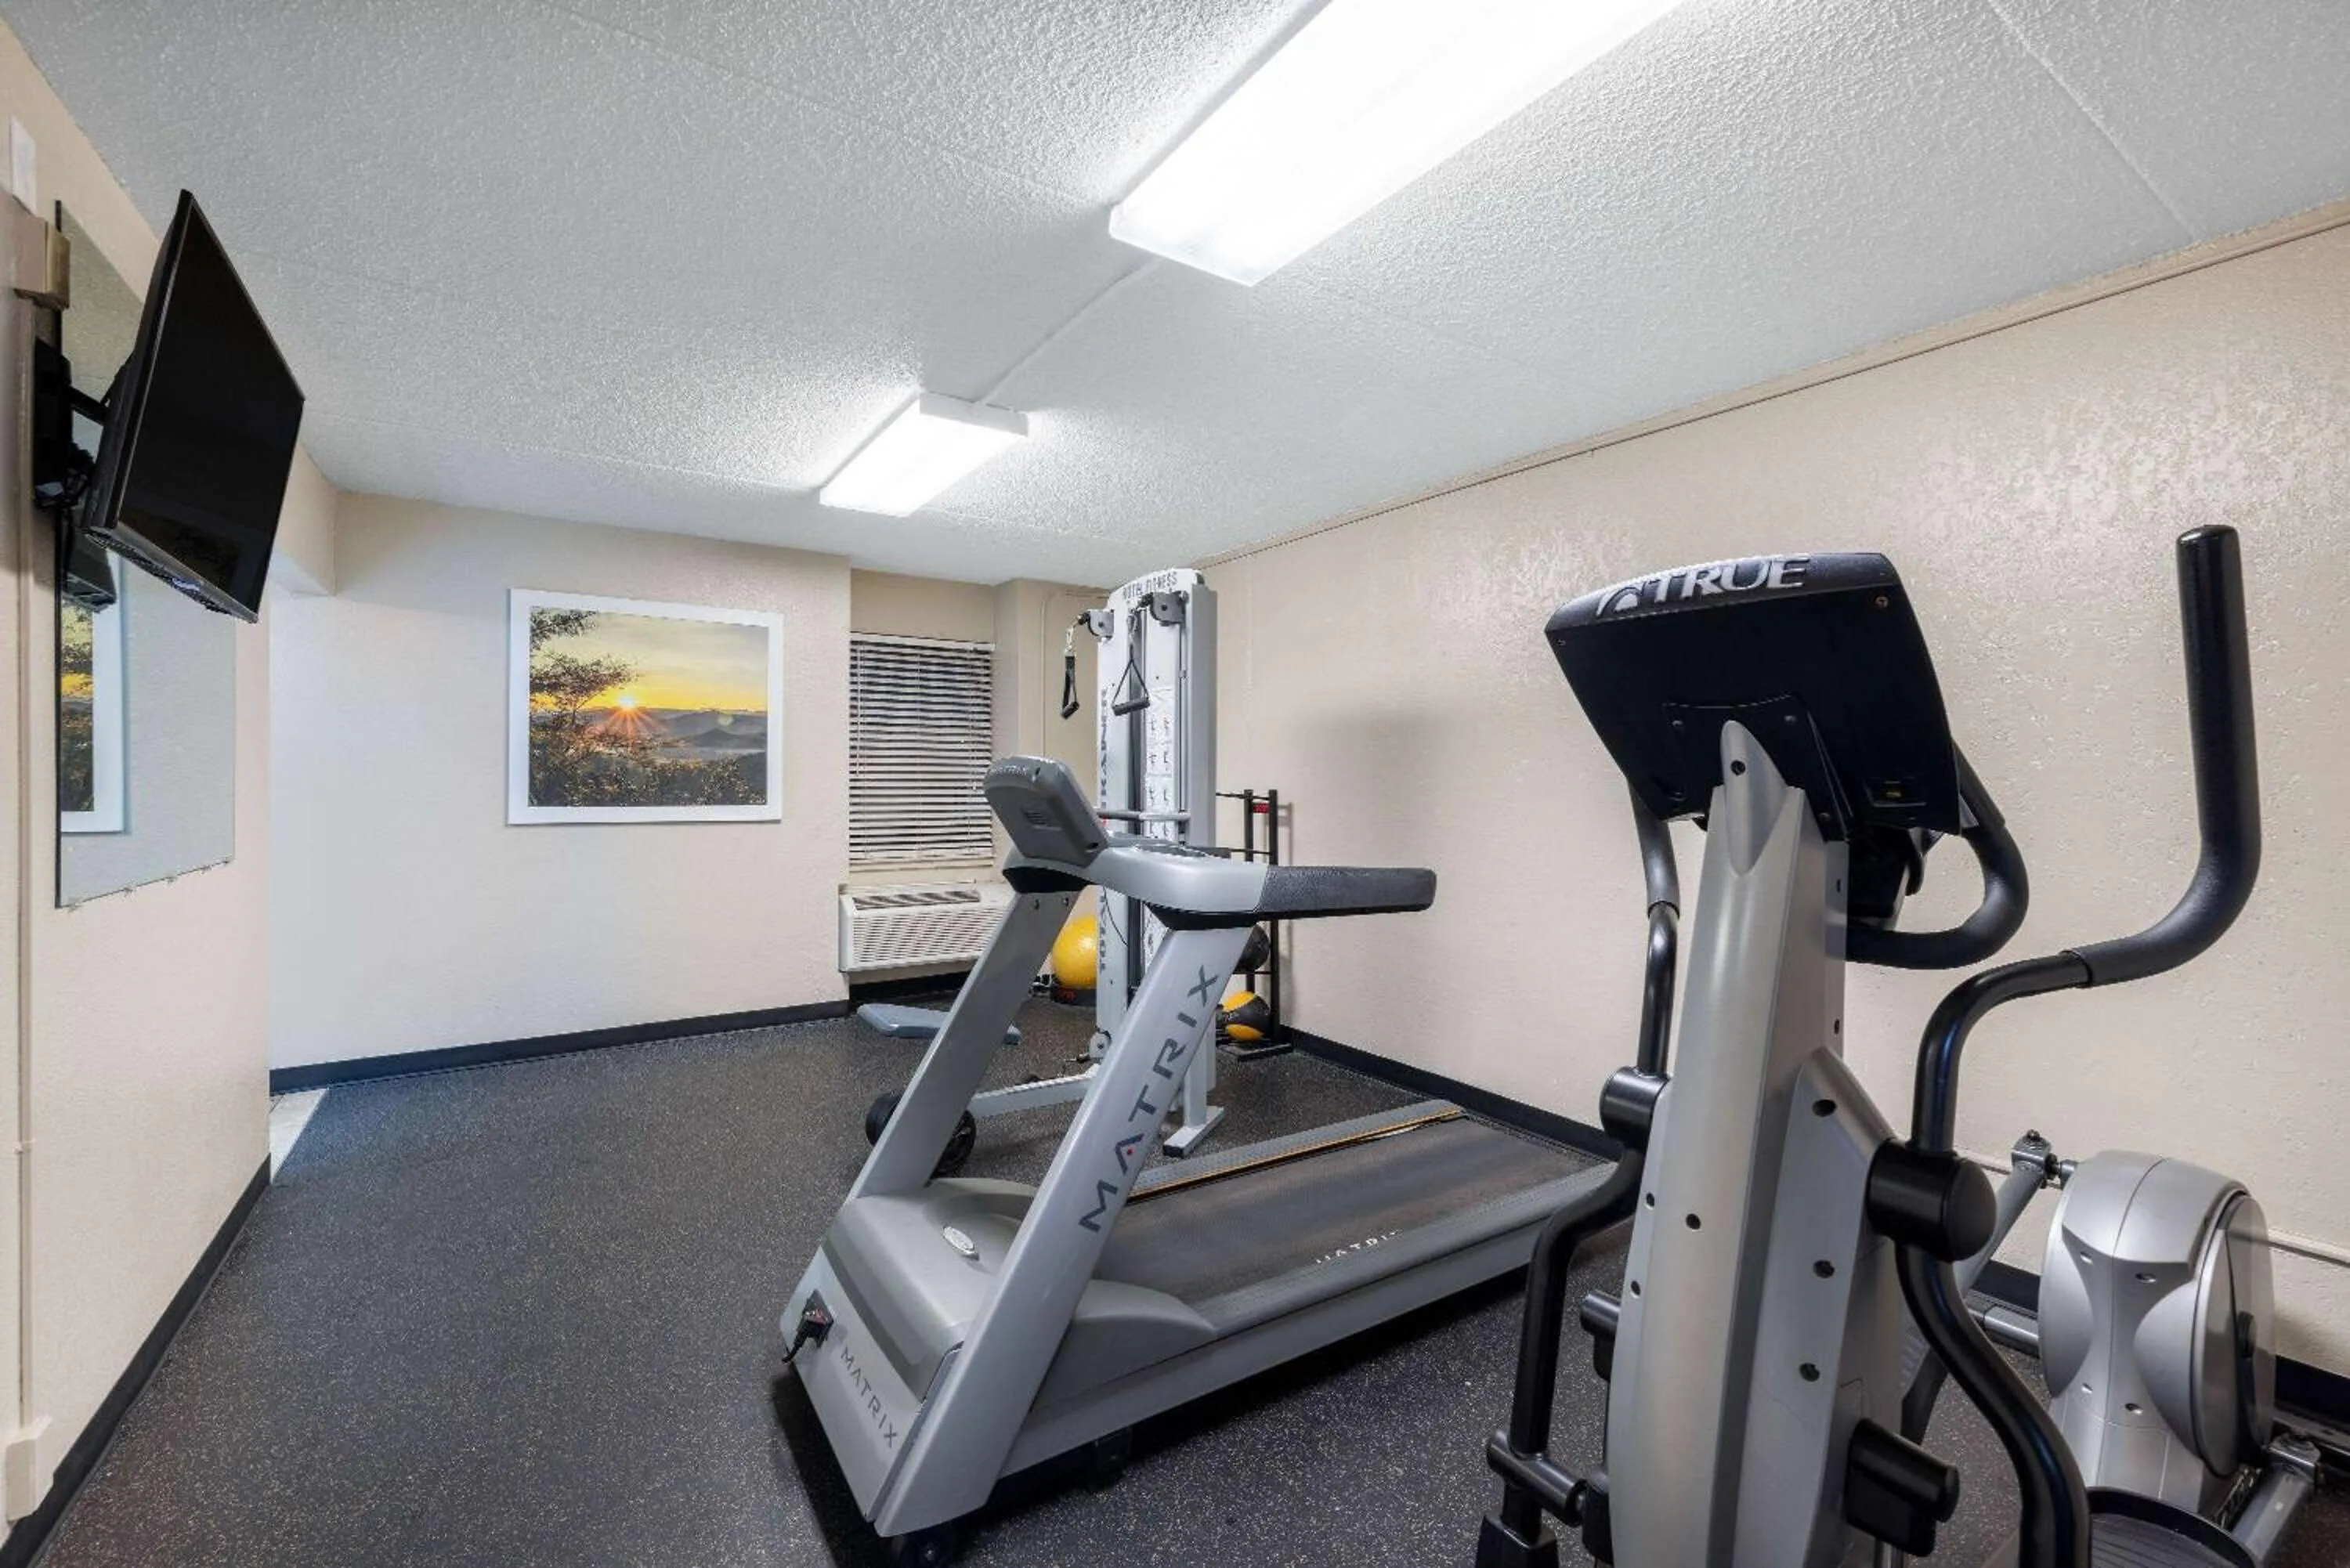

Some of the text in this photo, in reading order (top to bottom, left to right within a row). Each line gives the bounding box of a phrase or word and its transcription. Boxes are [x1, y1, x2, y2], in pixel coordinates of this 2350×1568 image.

[1647, 555, 1812, 603] TRUE
[1079, 964, 1219, 1233] MATRIX
[841, 1346, 898, 1449] MATRIX
